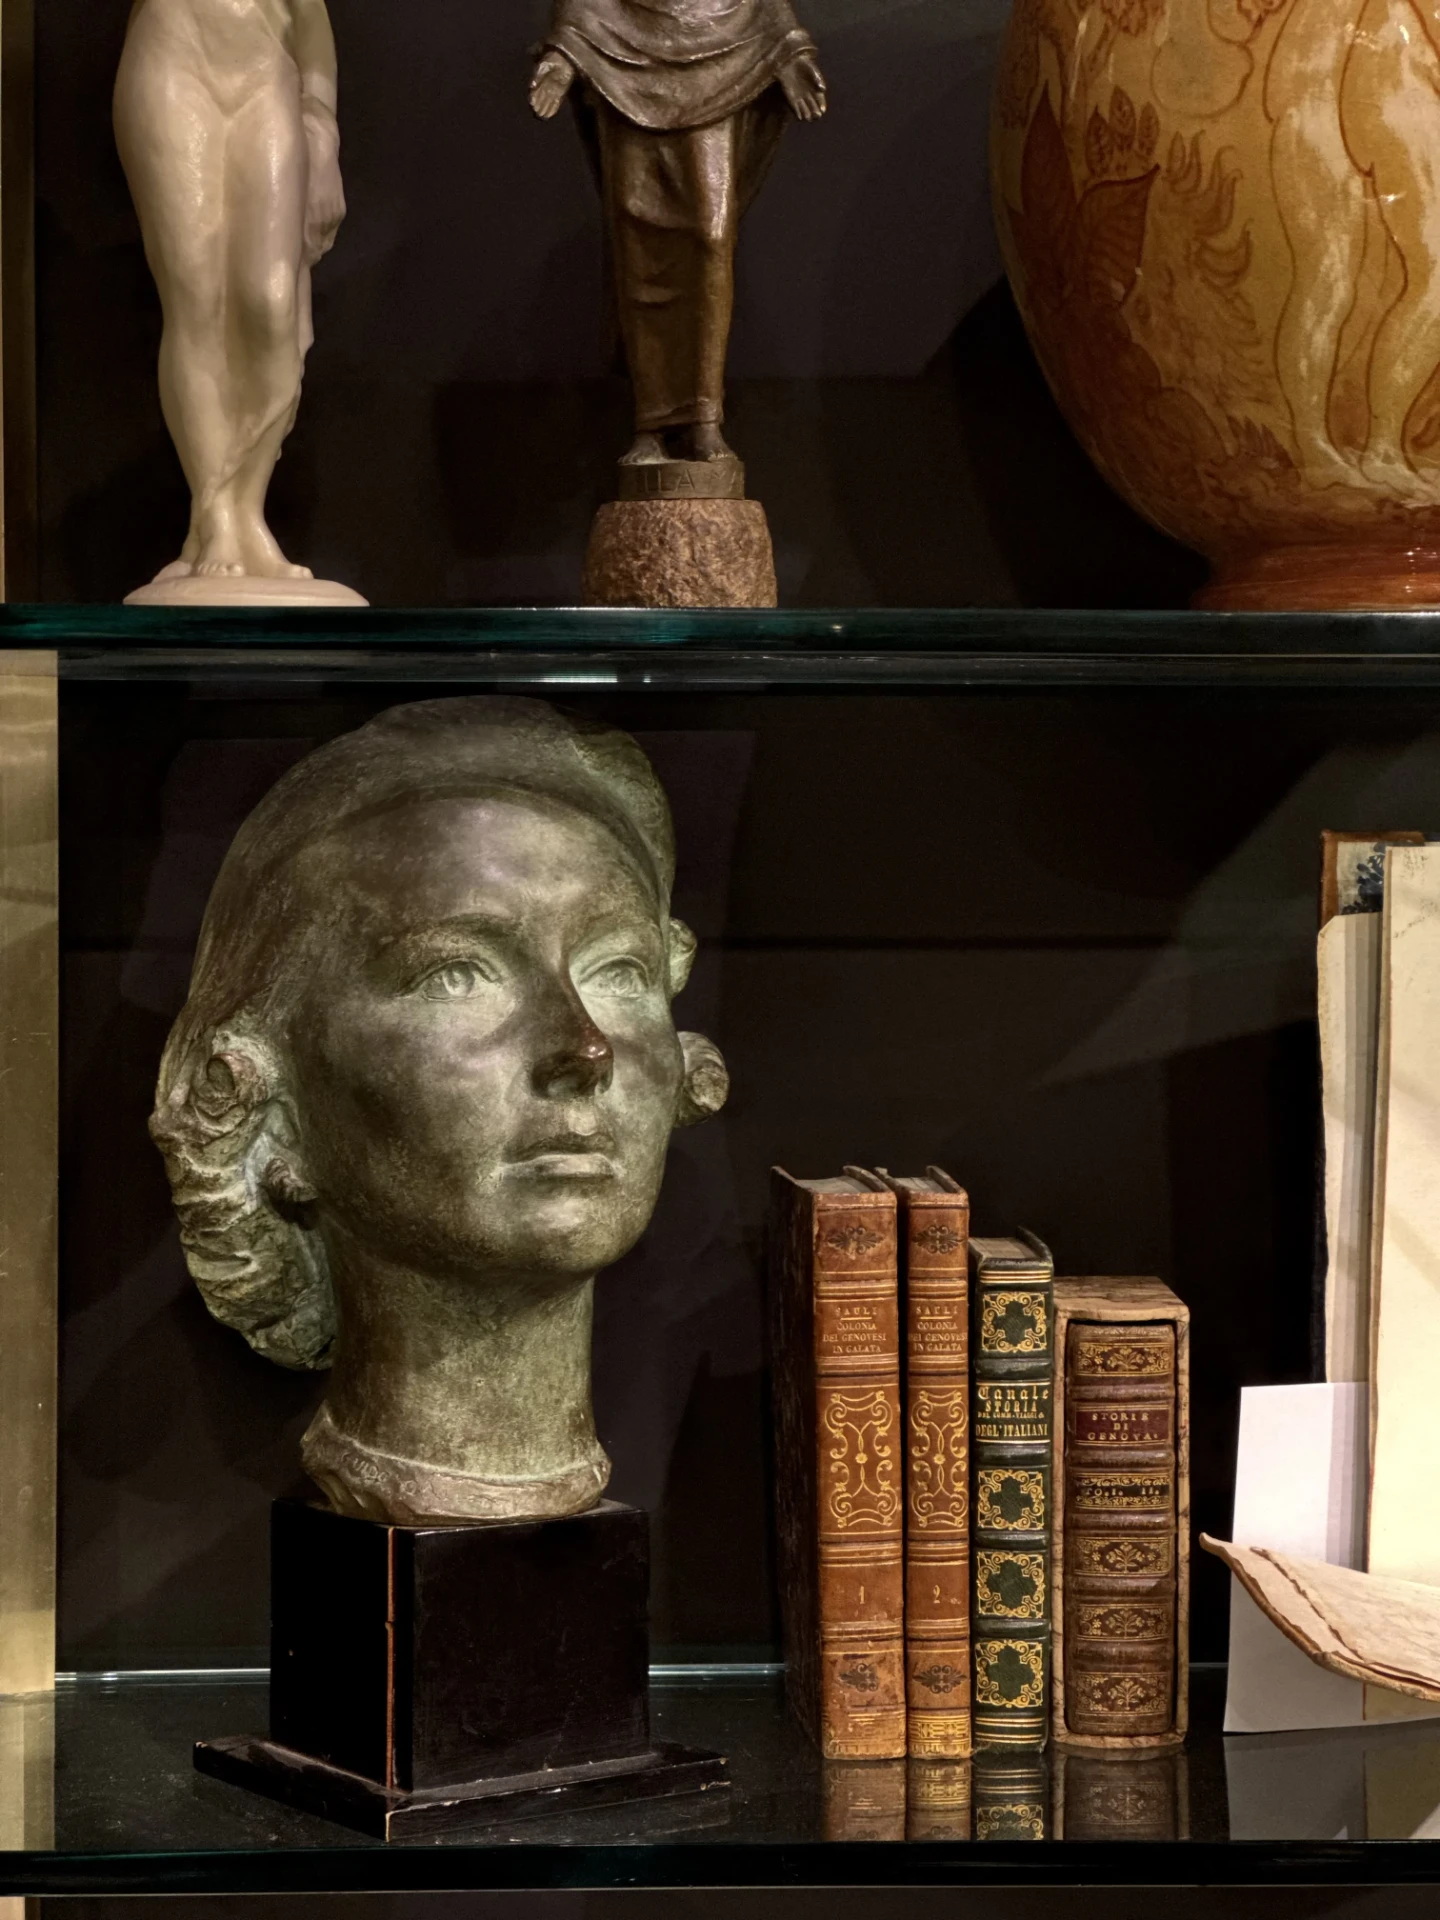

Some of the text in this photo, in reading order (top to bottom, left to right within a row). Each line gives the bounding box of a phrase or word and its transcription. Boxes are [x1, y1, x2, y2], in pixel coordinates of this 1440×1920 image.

[836, 1322, 877, 1331] COLONIA
[917, 1321, 958, 1330] COLONIA
[822, 1332, 887, 1342] DEI GENOVESI
[833, 1344, 882, 1354] IN GALATA
[914, 1342, 962, 1352] IN GALATA
[978, 1386, 1049, 1400] Canale
[985, 1400, 1037, 1412] STORIA
[1113, 1422, 1129, 1431] DI
[932, 1584, 941, 1604] 2
